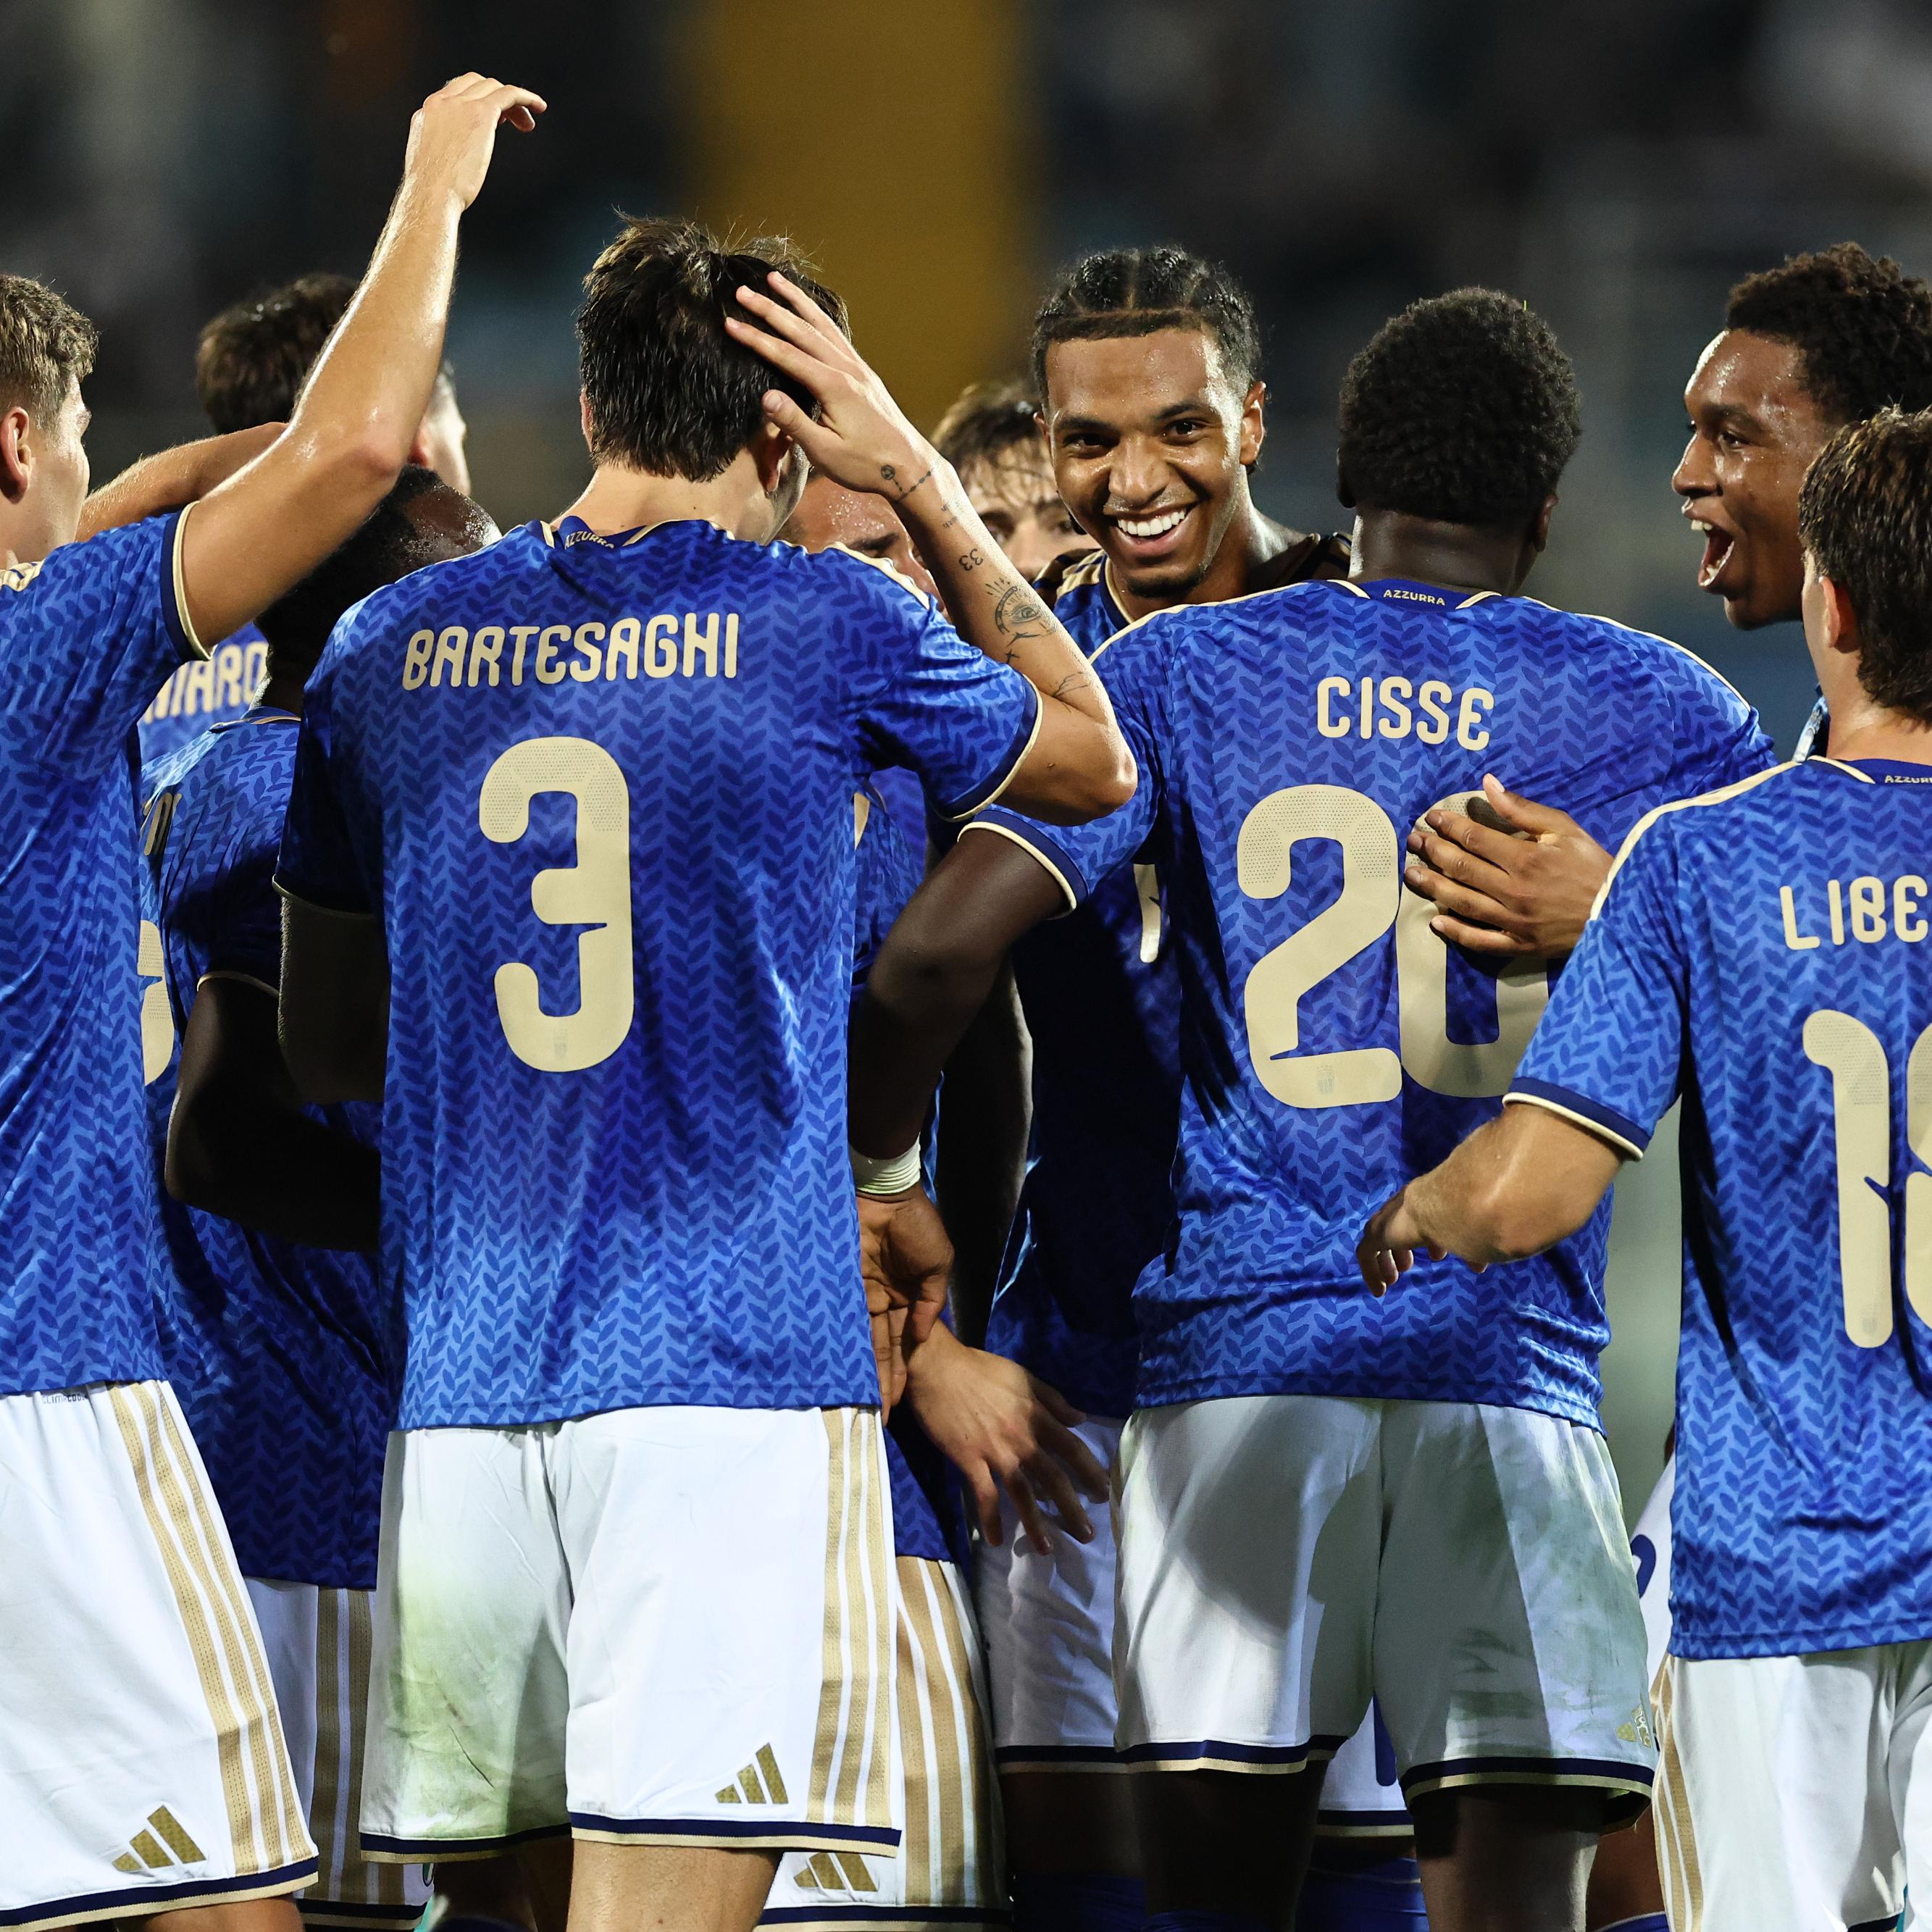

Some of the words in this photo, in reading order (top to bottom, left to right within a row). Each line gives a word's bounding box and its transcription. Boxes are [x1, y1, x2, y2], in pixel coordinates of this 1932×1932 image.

[958, 548, 984, 571] 33
[1383, 589, 1446, 606] AZZURRA
[402, 612, 739, 690] BARTESAGHI
[1317, 676, 1494, 751] CISSE
[479, 736, 635, 1072] 3
[1779, 874, 1928, 950] LIBE
[1802, 1009, 1932, 1348] 1
